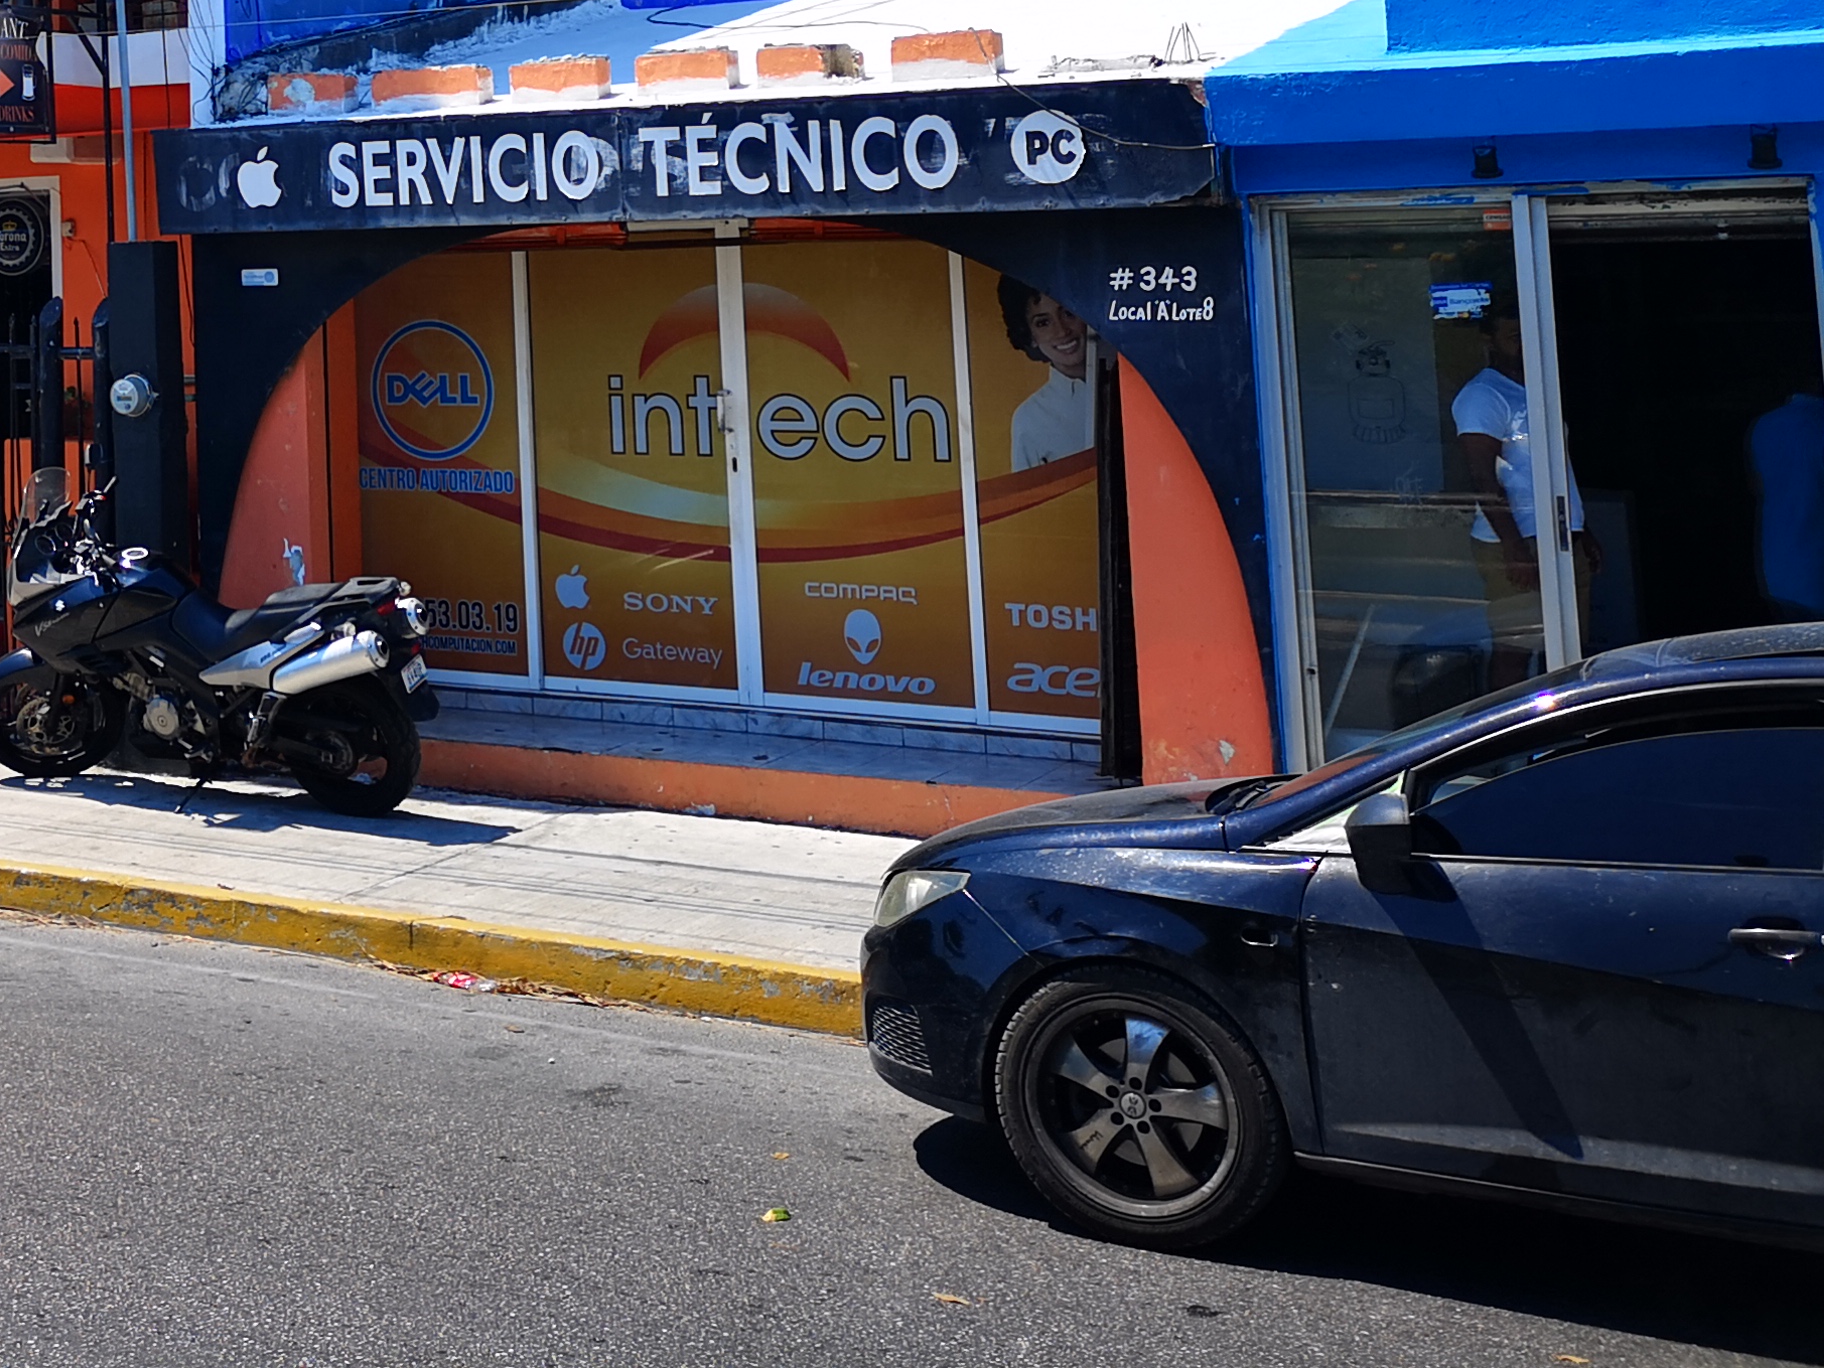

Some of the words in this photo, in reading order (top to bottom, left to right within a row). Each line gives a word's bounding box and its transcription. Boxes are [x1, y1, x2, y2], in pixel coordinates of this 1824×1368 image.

[328, 130, 600, 208] SERVICIO
[638, 113, 959, 197] TÉCNICO
[1025, 129, 1077, 166] PC
[0, 242, 20, 252] Extra
[386, 371, 479, 408] DELL
[359, 467, 416, 491] CENTRO
[420, 469, 514, 494] AUTORIZADO
[623, 592, 719, 615] SONY
[804, 582, 918, 605] COMPAQ
[567, 622, 603, 671] hp
[622, 638, 722, 670] Gateway
[797, 661, 936, 695] lenovo
[1006, 662, 1101, 698] ace
